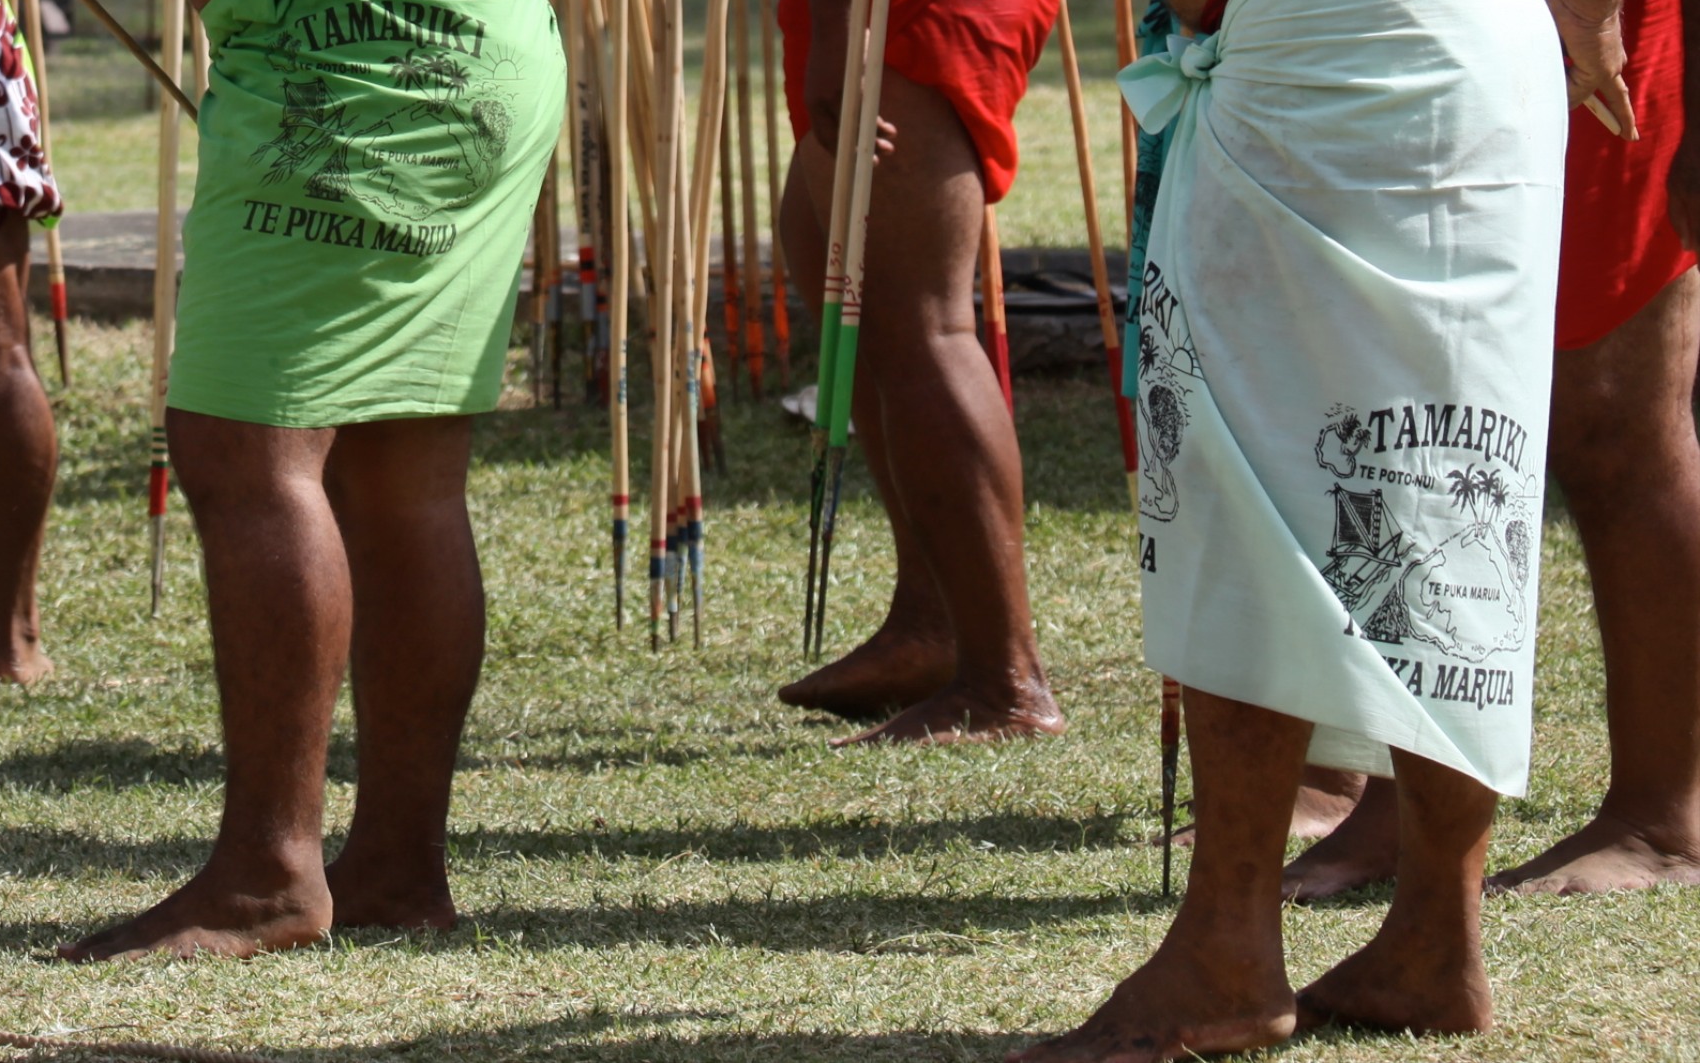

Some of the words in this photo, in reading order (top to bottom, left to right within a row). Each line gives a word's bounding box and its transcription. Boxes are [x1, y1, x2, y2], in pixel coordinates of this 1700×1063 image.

[294, 0, 487, 59] TAMARIKI
[372, 148, 385, 162] TE
[388, 150, 418, 165] PUKA
[243, 200, 282, 235] TE
[283, 206, 366, 249] PUKA
[370, 221, 457, 258] MARUIA
[1367, 403, 1528, 473] TAMARIKI
[1359, 464, 1376, 480] TE
[1379, 468, 1436, 490] POTO-NUI
[1428, 581, 1441, 596] TE
[1443, 583, 1468, 598] PUKA
[1469, 586, 1501, 602] MARUIA
[1430, 664, 1514, 711] MARUIA
